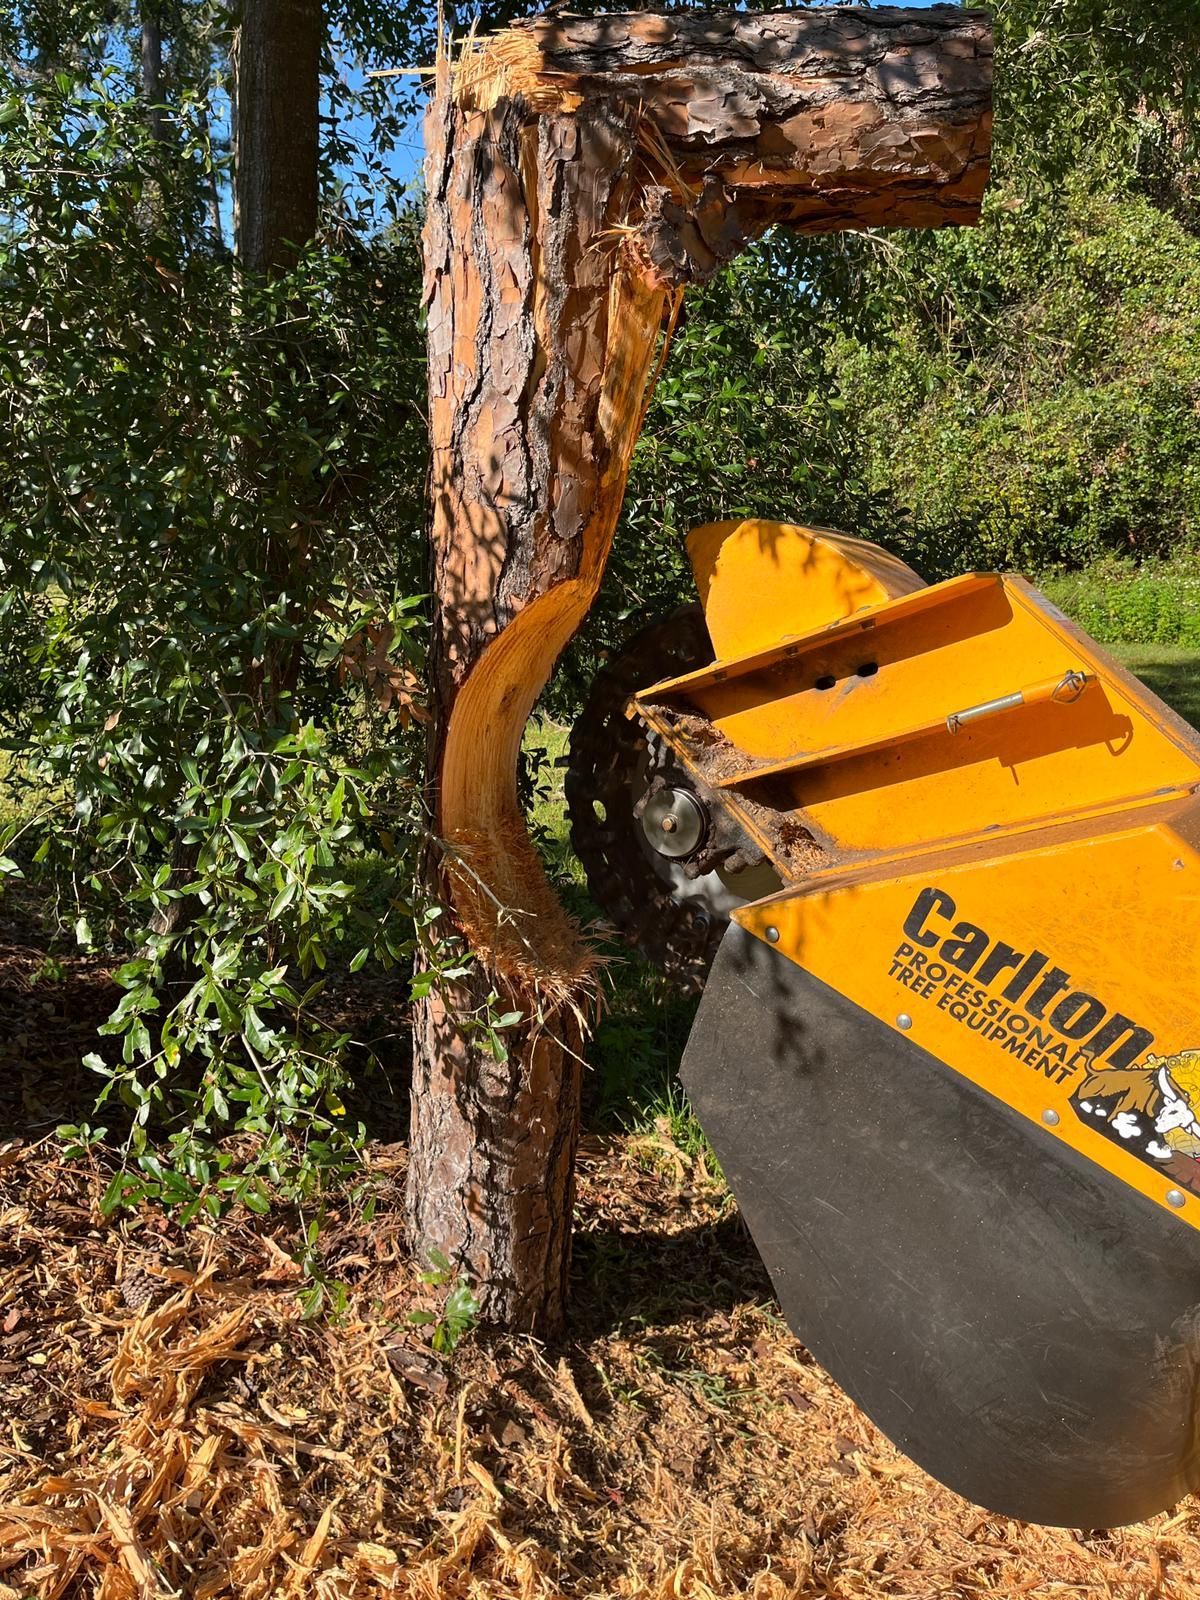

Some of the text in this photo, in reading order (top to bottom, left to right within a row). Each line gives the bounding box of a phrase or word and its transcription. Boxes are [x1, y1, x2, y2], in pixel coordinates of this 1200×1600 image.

[887, 959, 1075, 1085] TREE EQUIPMENT
[894, 942, 1082, 1071] PROFESSIONAL
[902, 887, 1155, 1069] Carlton
